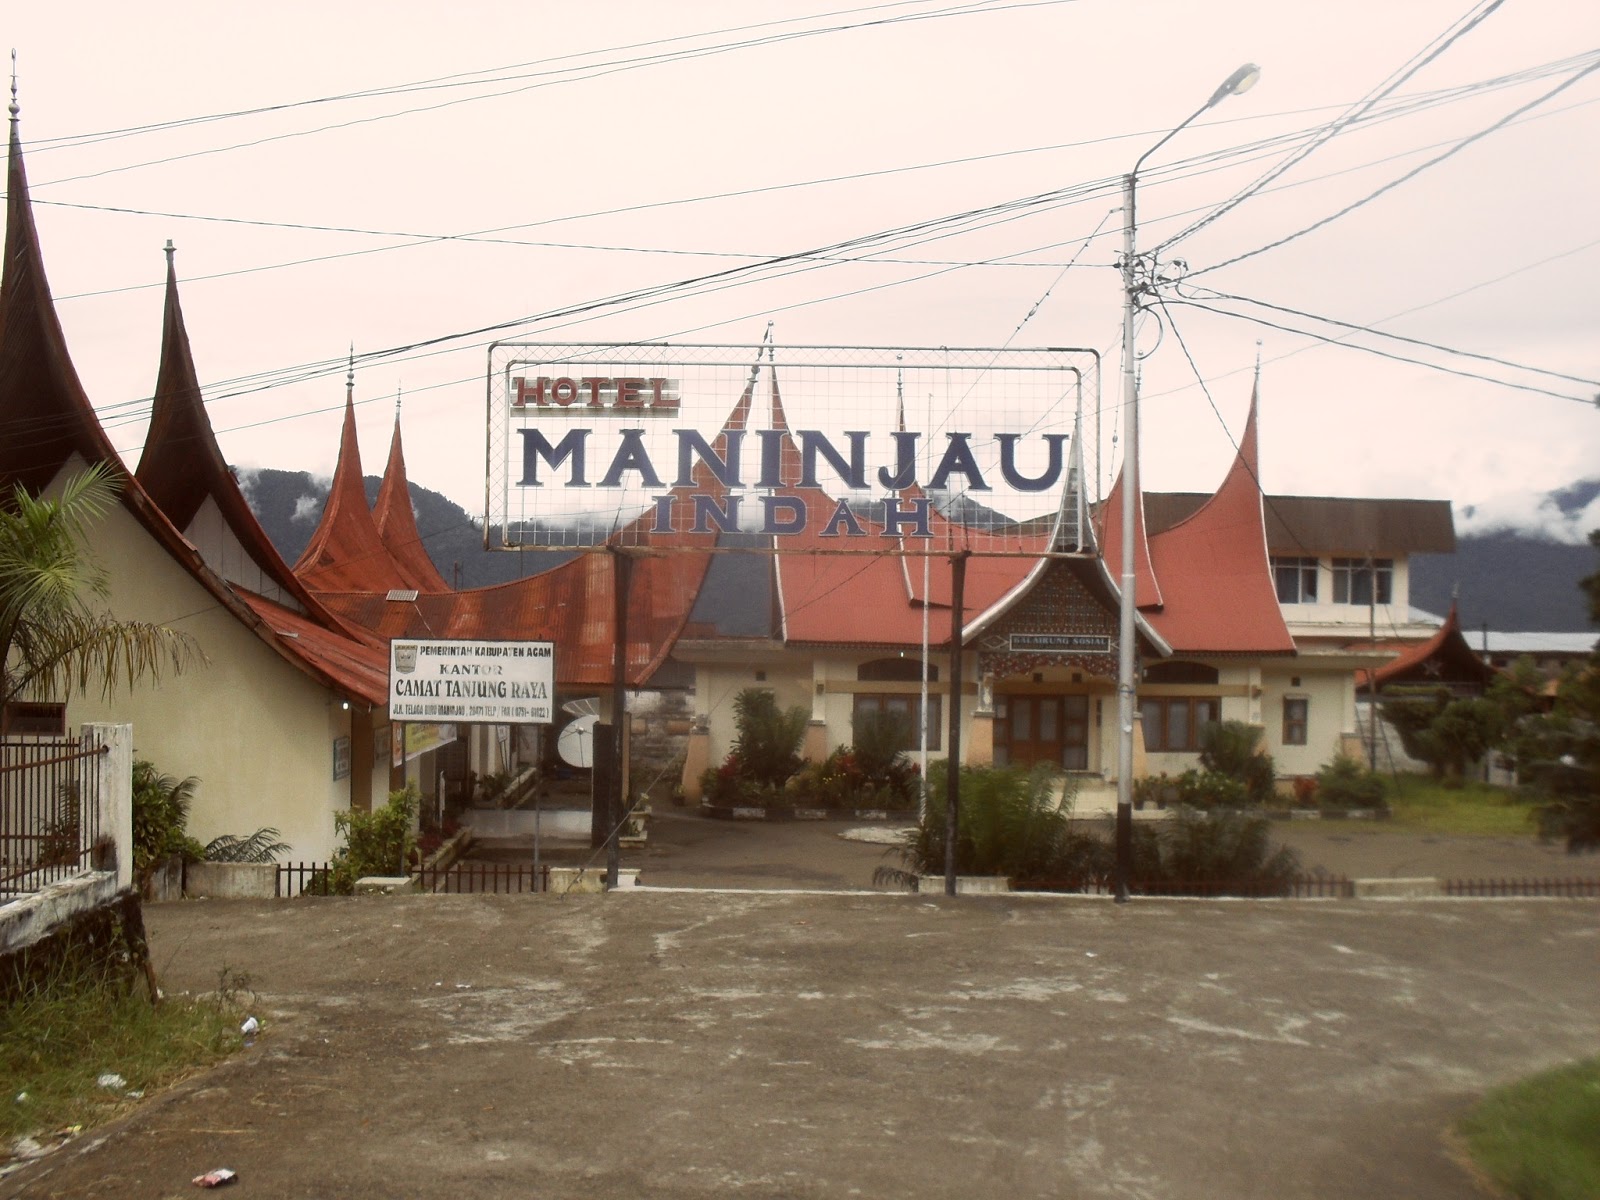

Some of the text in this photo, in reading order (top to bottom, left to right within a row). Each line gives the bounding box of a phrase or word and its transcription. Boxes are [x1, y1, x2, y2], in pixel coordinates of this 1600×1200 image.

[511, 376, 681, 408] HOTEL
[514, 427, 1070, 492] MANINJAU
[649, 493, 935, 538] INDAH
[1072, 637, 1106, 646] SOSIAL
[420, 645, 551, 658] PEMERINTAH KABUPATEN AGAM
[439, 663, 503, 676] KANTOR
[395, 678, 548, 700] CAMAT TANJUNG RAYA
[405, 703, 423, 716] TELAGA
